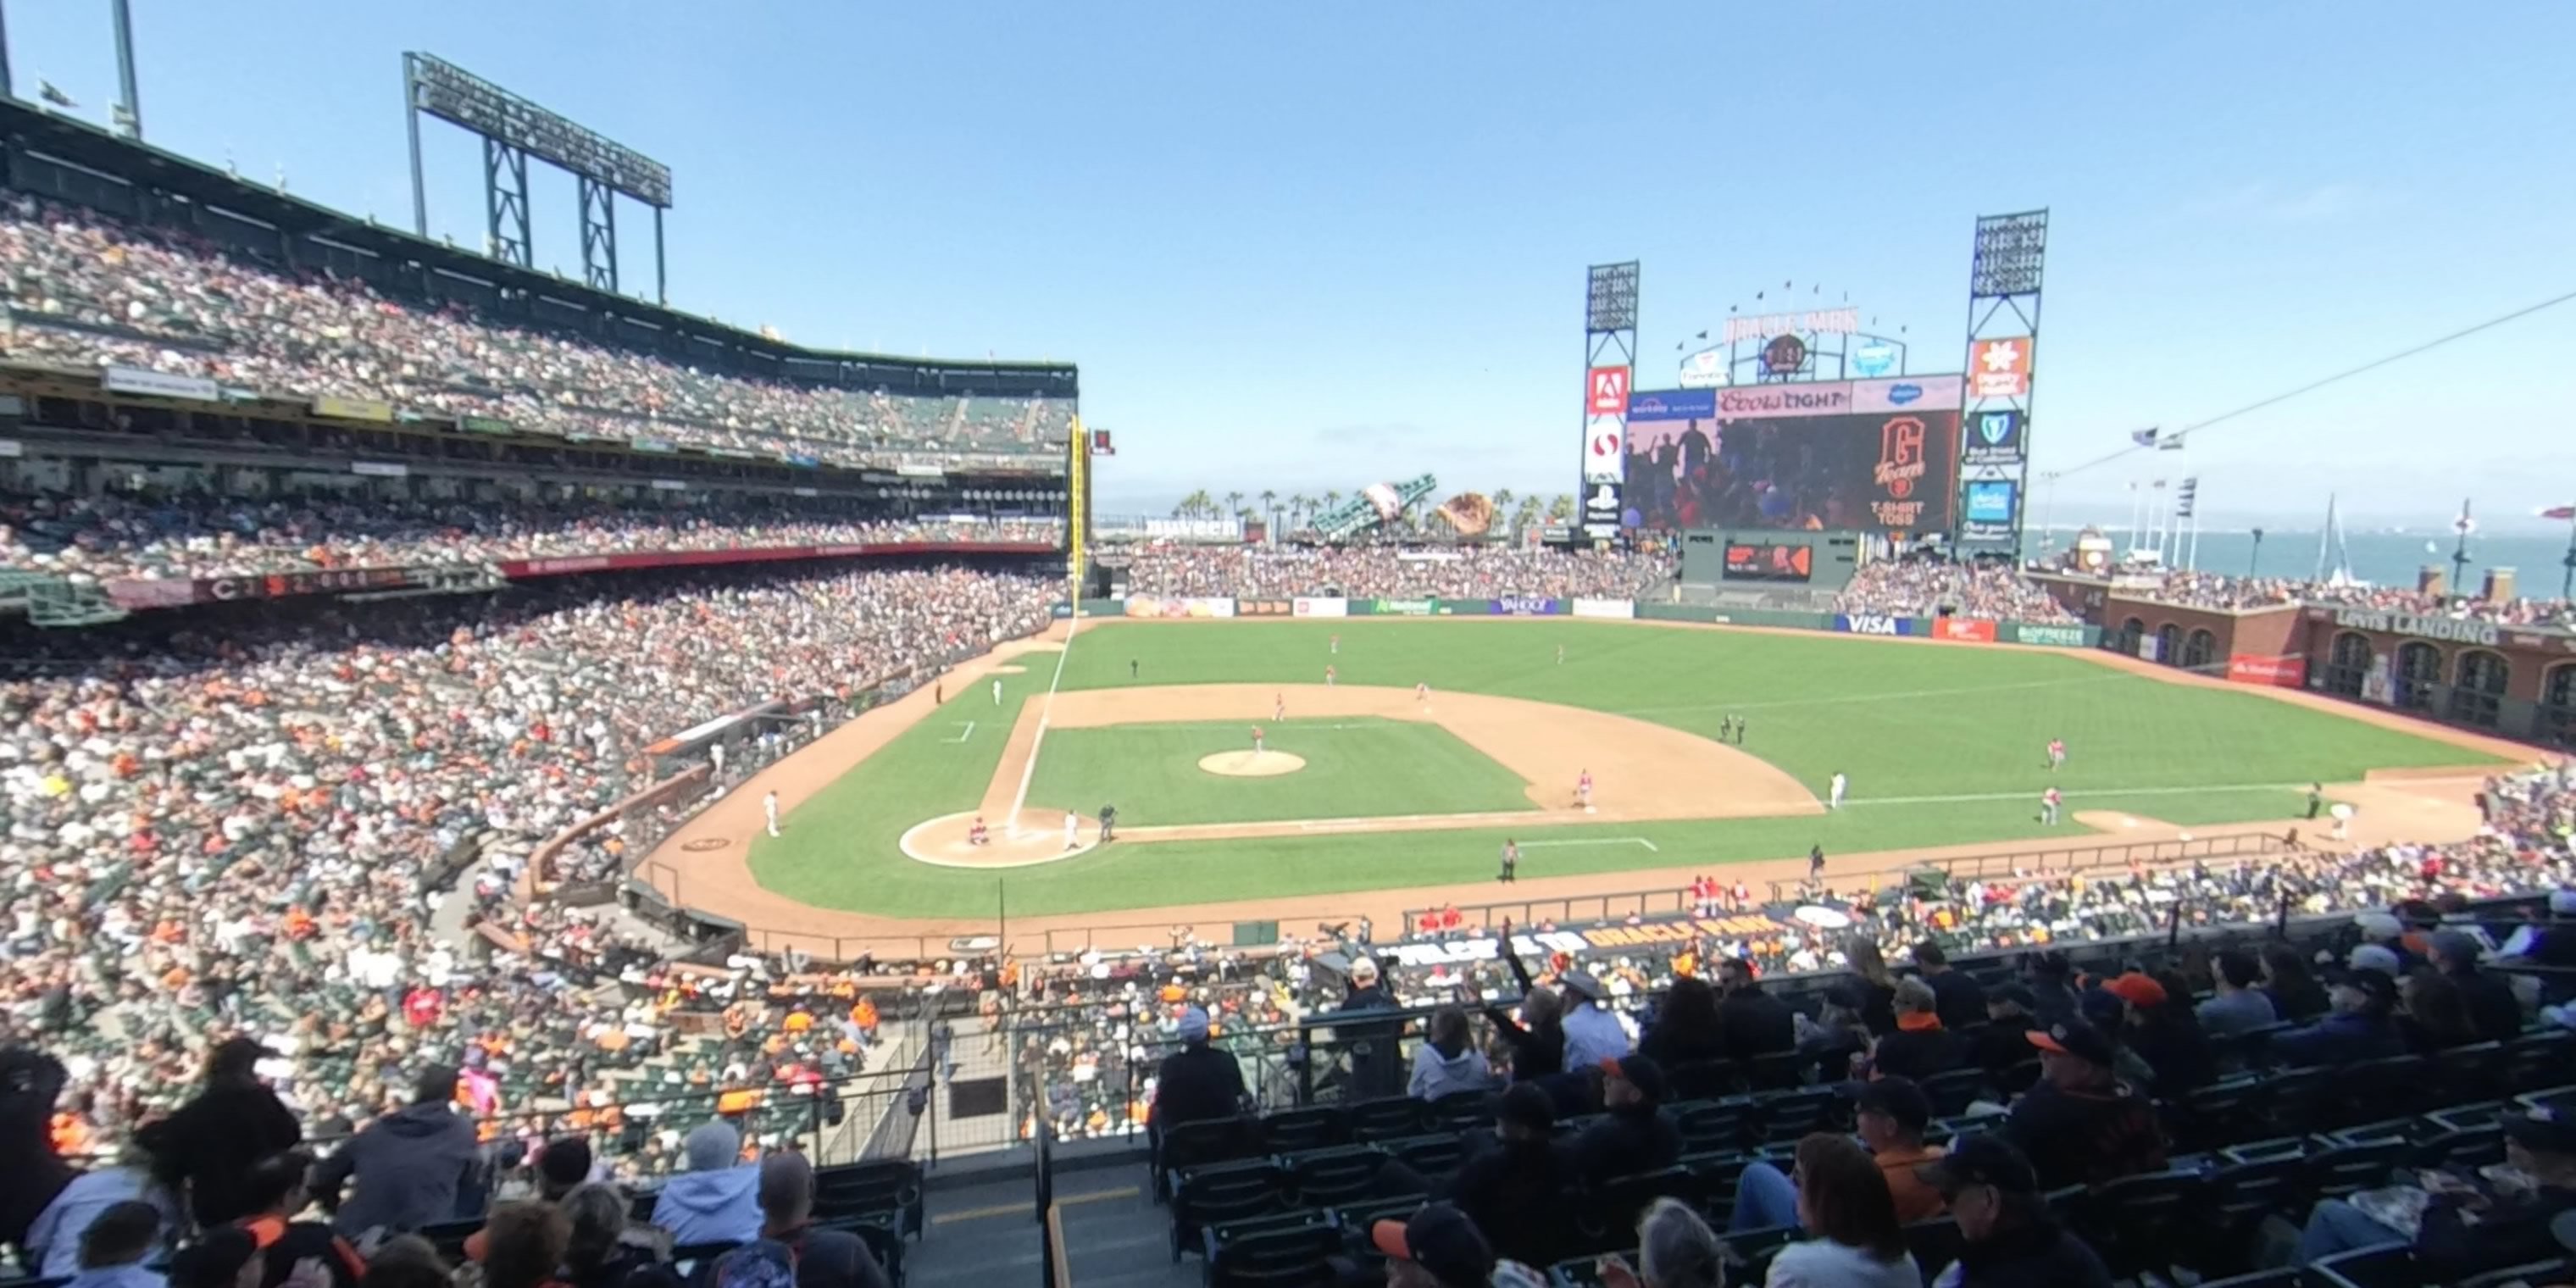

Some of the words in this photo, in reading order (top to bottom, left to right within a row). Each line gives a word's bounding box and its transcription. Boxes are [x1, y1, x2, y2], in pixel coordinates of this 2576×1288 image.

[1803, 308, 1859, 334] PARK
[1720, 391, 1780, 413] Coors
[1783, 392, 1840, 408] LIGHT
[1870, 501, 1924, 514] T-SHIRT
[1146, 519, 1238, 536] nuveen
[1878, 512, 1914, 525] TOSS
[1847, 614, 1897, 635] VISA
[2394, 616, 2498, 646] LANDING
[1582, 920, 1705, 947] ORACLE
[1696, 914, 1785, 936] PARK
[1535, 932, 1587, 951] TO
